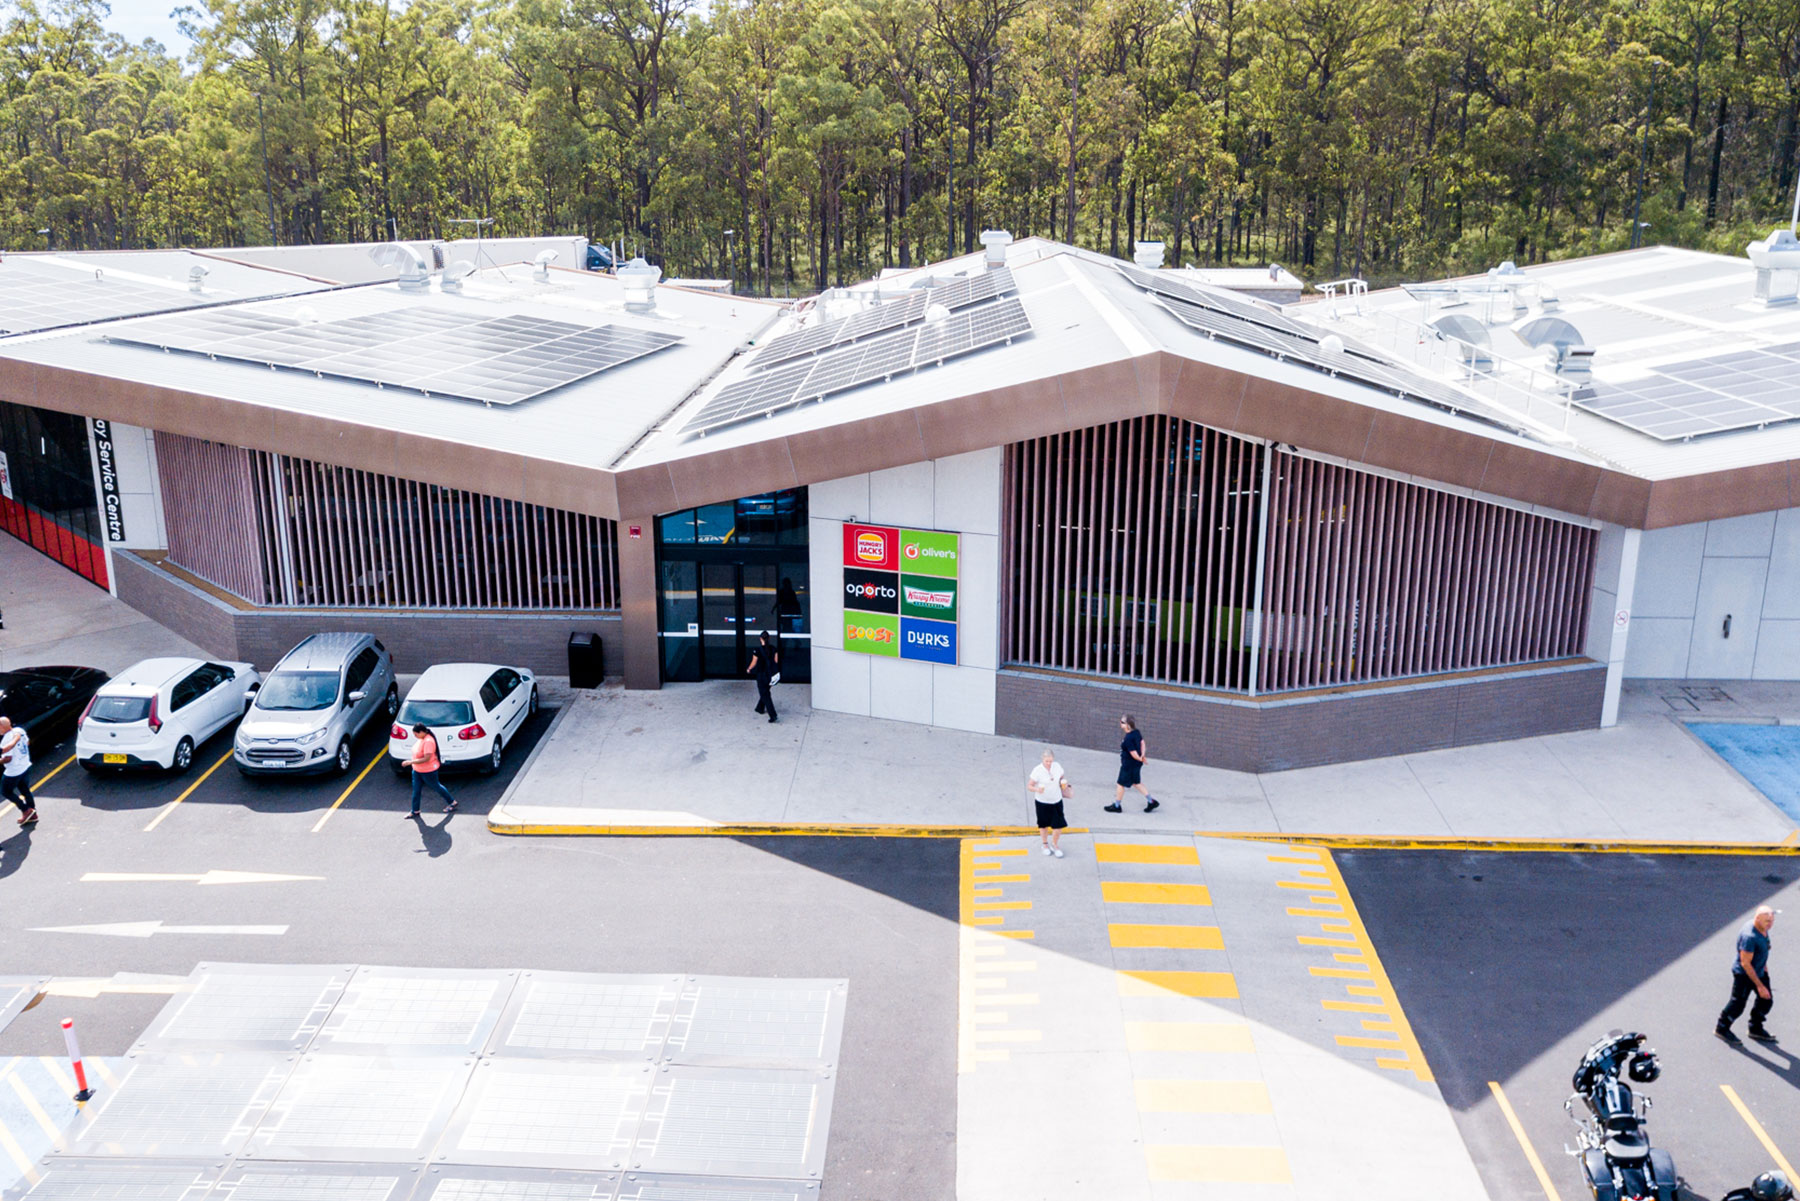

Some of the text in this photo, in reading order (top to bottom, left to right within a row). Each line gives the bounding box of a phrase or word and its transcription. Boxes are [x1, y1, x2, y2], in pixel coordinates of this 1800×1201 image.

[99, 441, 115, 491] Service
[106, 494, 121, 541] Centre
[921, 547, 956, 559] oliver's
[846, 583, 896, 598] oporto
[847, 624, 895, 643] BOOST
